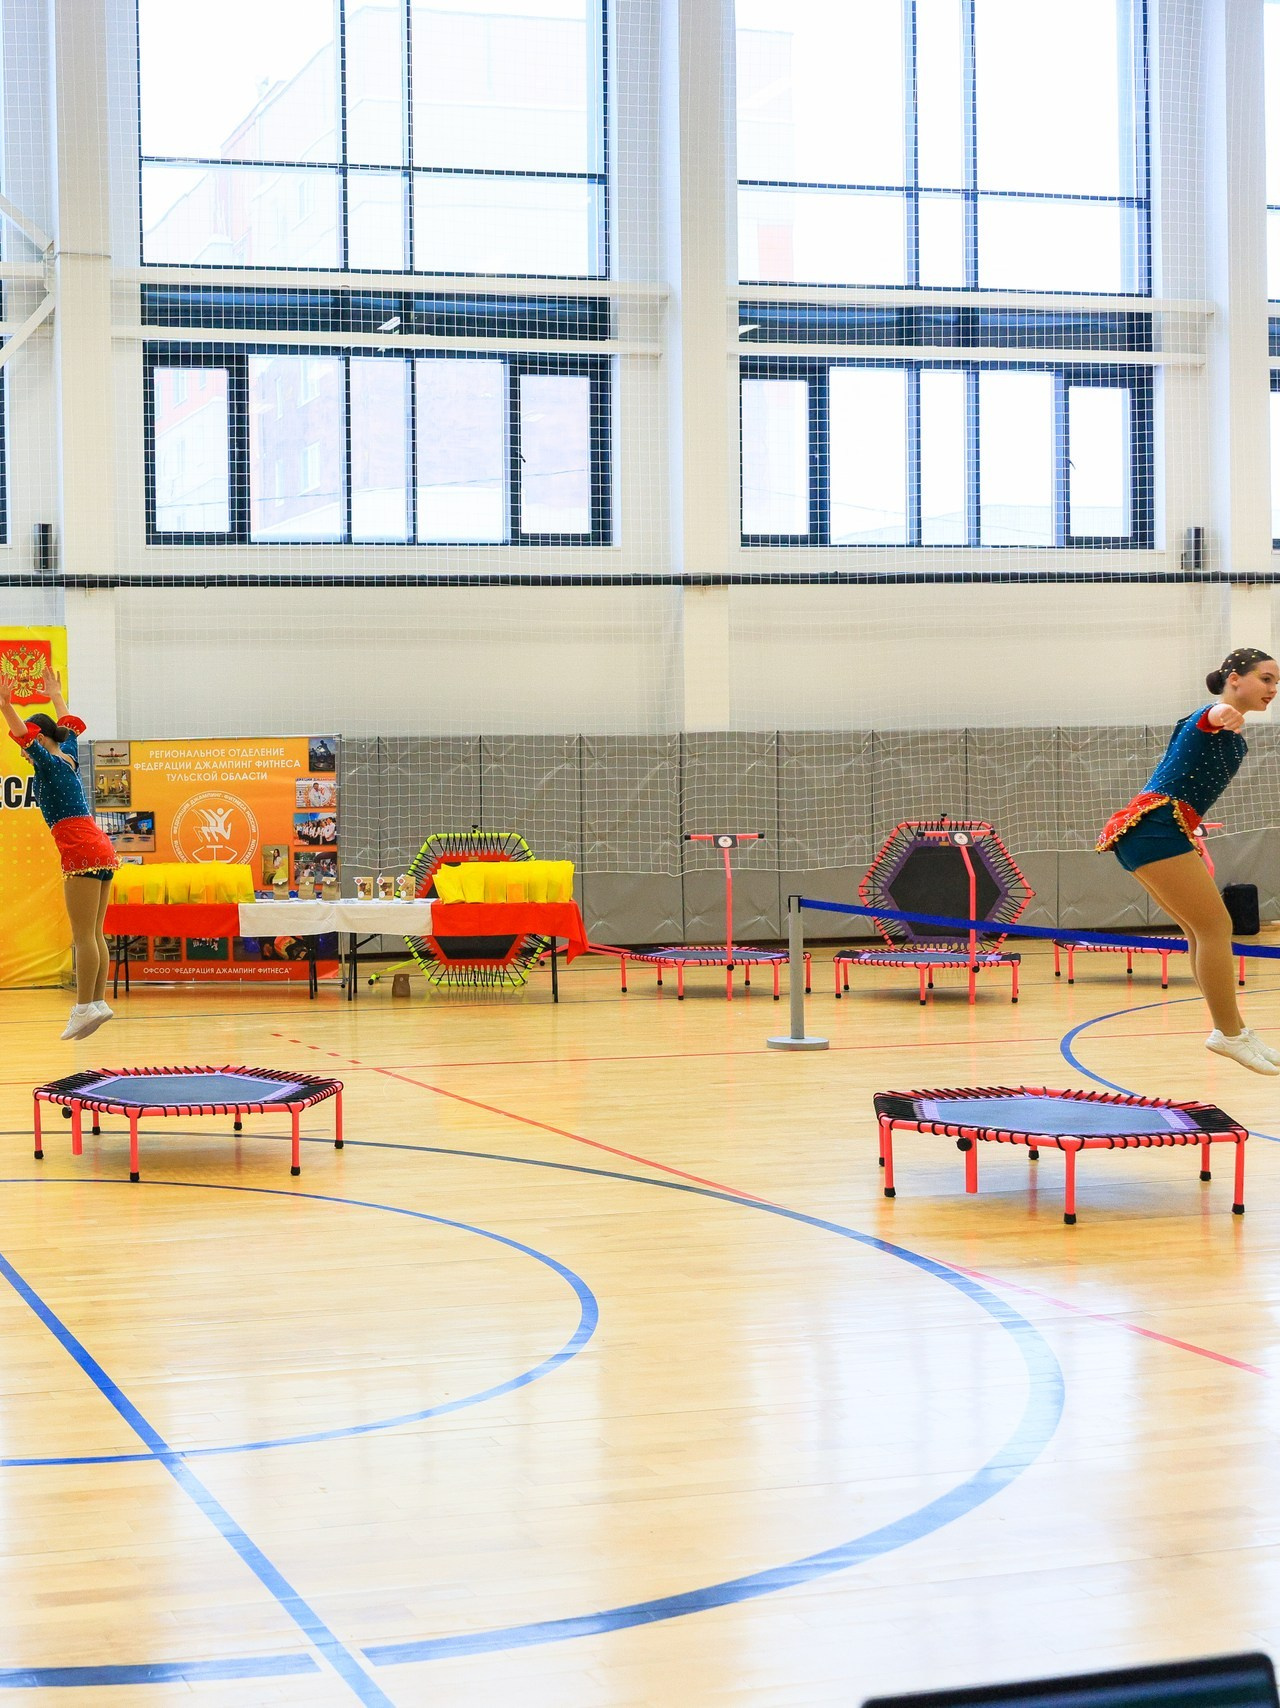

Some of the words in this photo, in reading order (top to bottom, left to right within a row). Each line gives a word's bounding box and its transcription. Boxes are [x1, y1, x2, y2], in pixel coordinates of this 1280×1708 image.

[149, 748, 226, 759] РЕГИОНАЛЬНОЕ
[228, 747, 285, 758] ОТДЕЛЕНИЕ
[133, 760, 192, 771] ФЕДЕРАЦИИ
[194, 759, 253, 770] ДЖАМПИНГ
[254, 758, 301, 769] ФИТНЕСА
[166, 770, 218, 782] ТУЛЬСКОЙ
[221, 771, 268, 781] ОБЛАСТИ
[240, 839, 256, 864] DERATION
[216, 967, 256, 975] ДЖАМПИНГ
